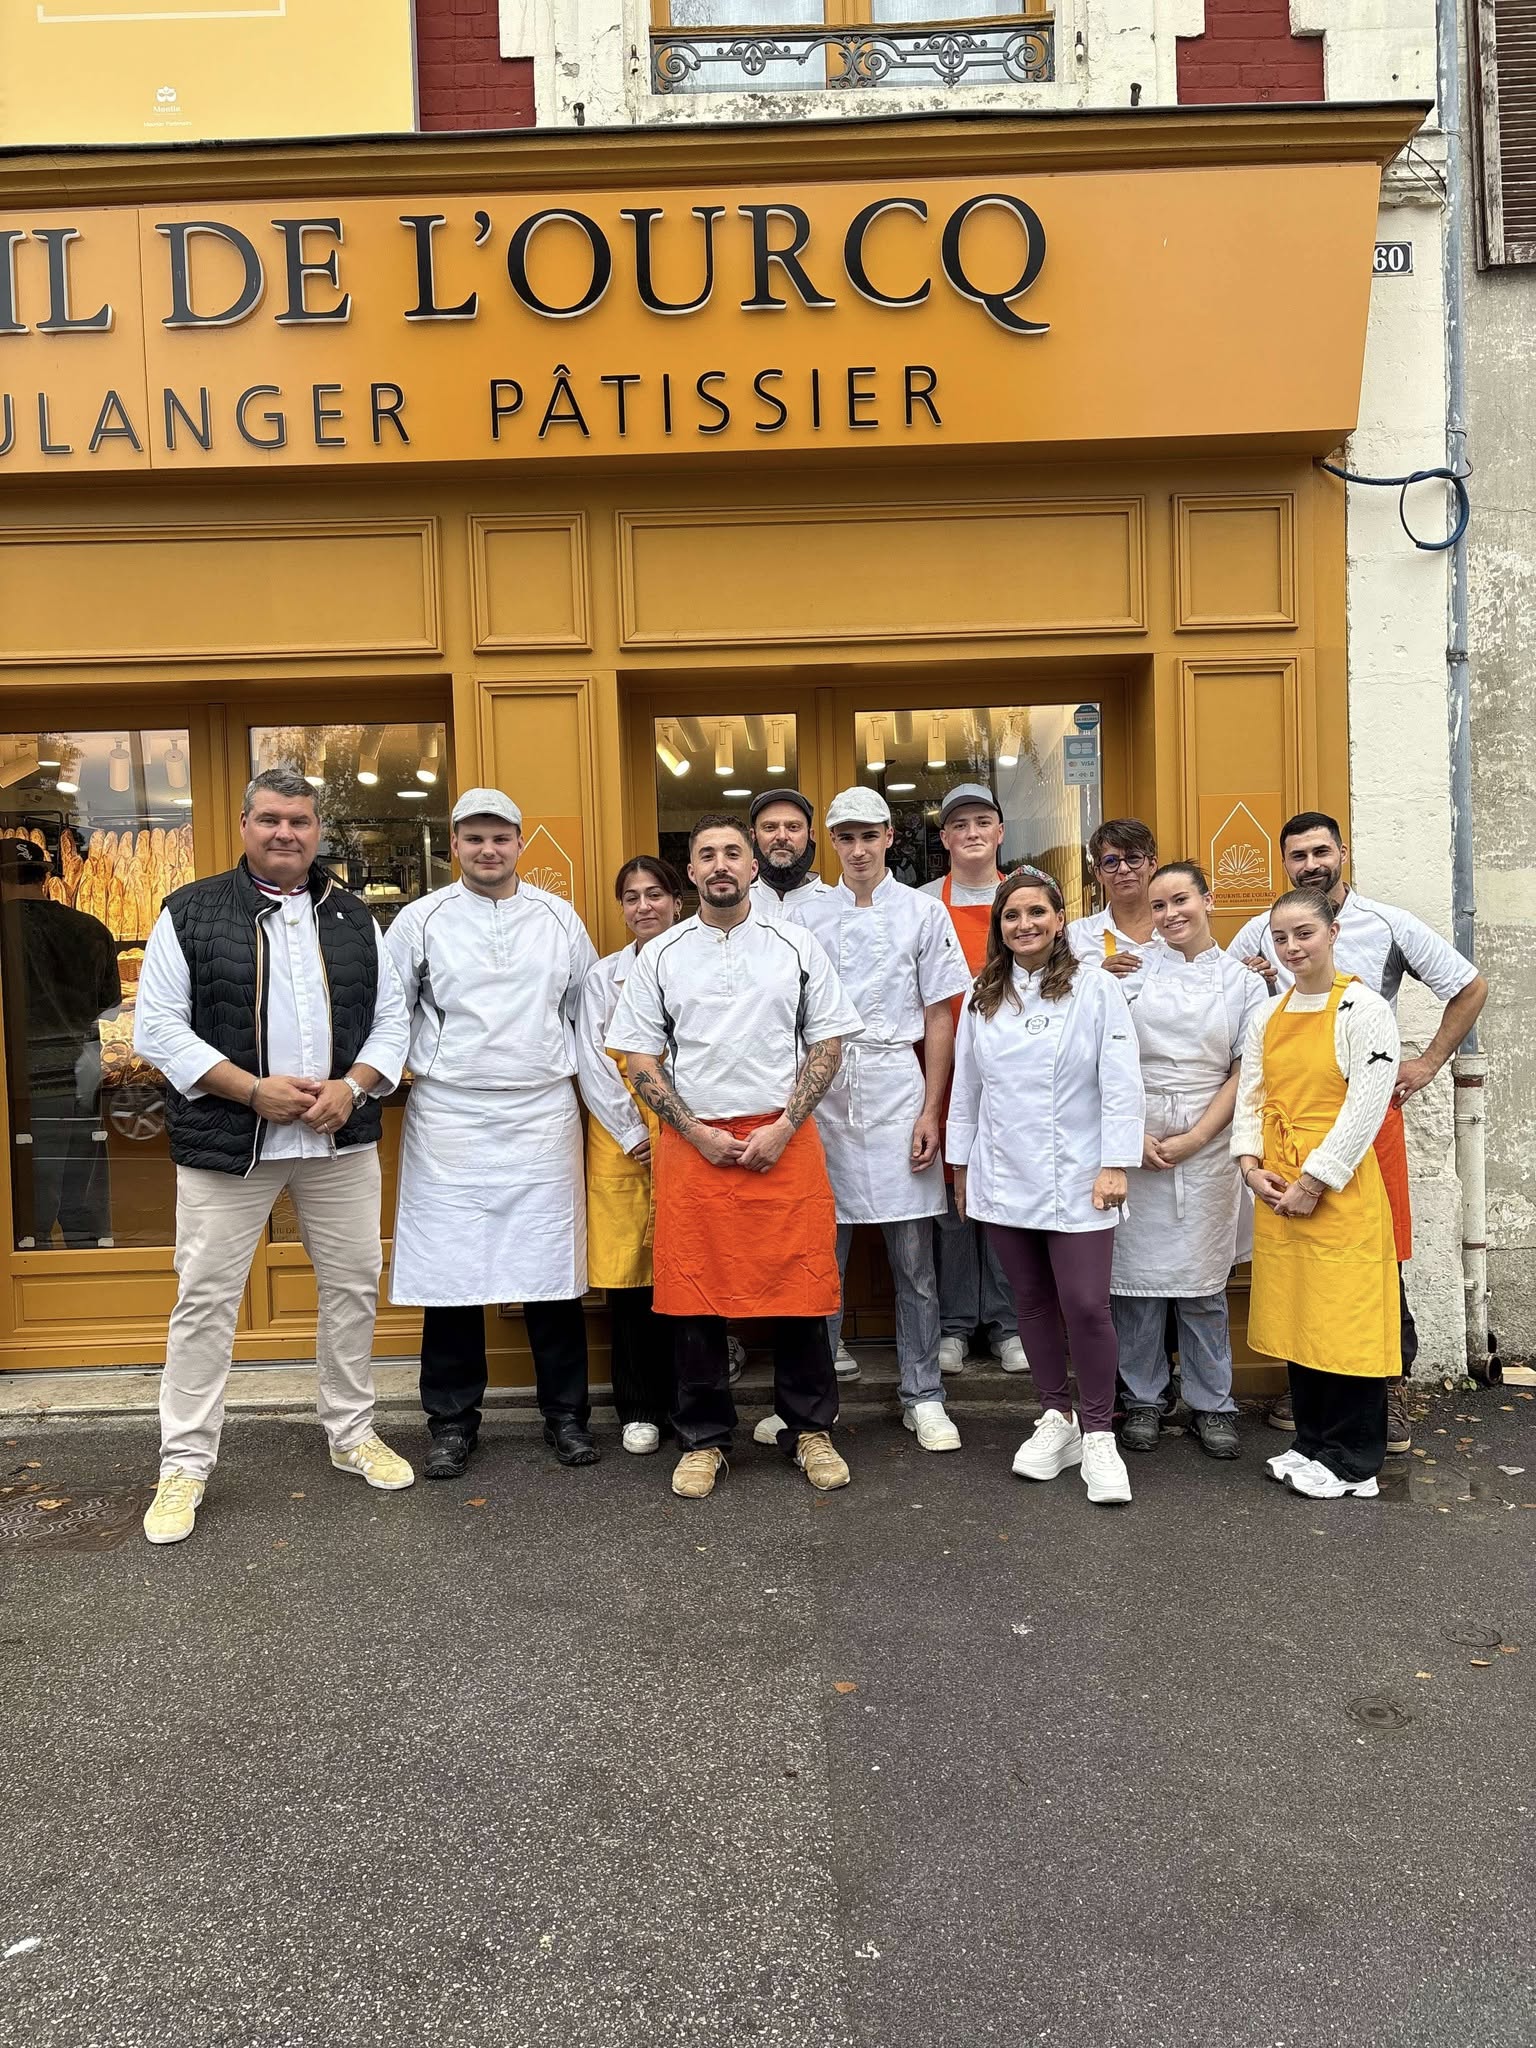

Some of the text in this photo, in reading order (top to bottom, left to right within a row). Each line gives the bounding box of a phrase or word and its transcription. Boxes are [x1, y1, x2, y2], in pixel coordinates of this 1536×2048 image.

[155, 217, 352, 329] DE
[399, 193, 1050, 335] L'OURCQ
[1373, 246, 1404, 271] 60
[490, 363, 943, 440] PÂTISSIER
